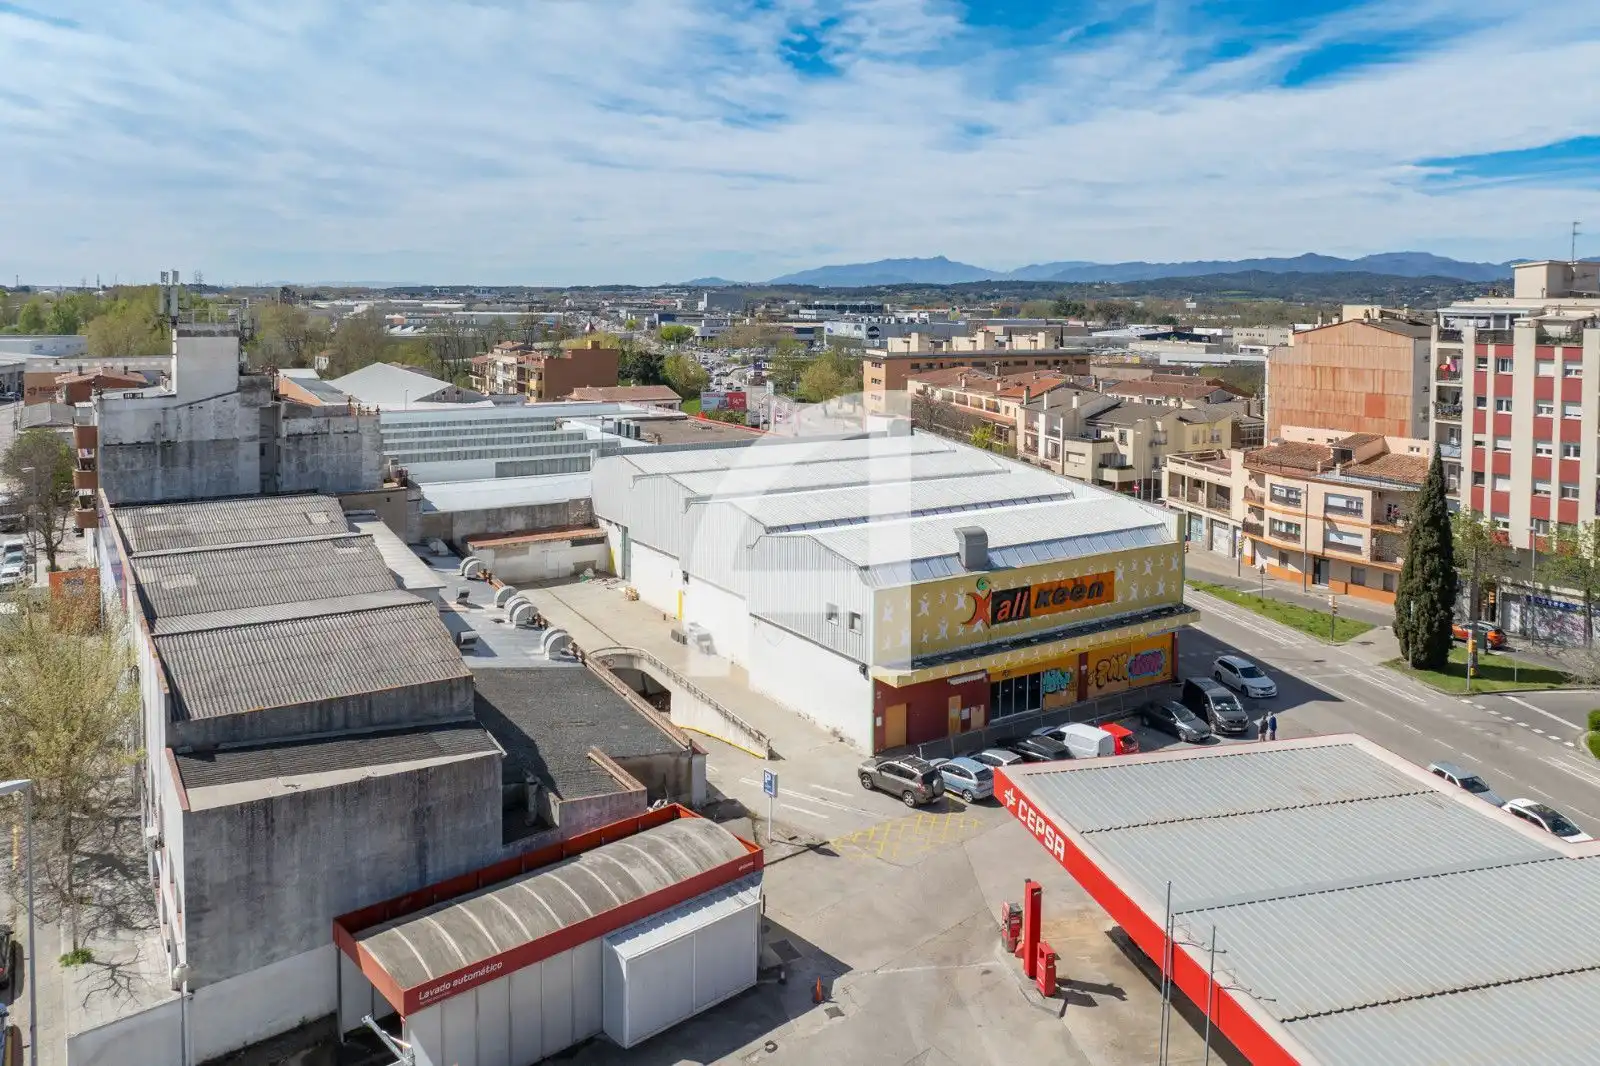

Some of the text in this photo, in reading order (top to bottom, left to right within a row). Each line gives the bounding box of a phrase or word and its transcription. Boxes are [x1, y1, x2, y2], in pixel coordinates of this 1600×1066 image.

[997, 591, 1029, 621] all
[1018, 799, 1066, 862] CEPSA
[418, 982, 451, 1000] Lavado
[452, 961, 503, 987] automático
